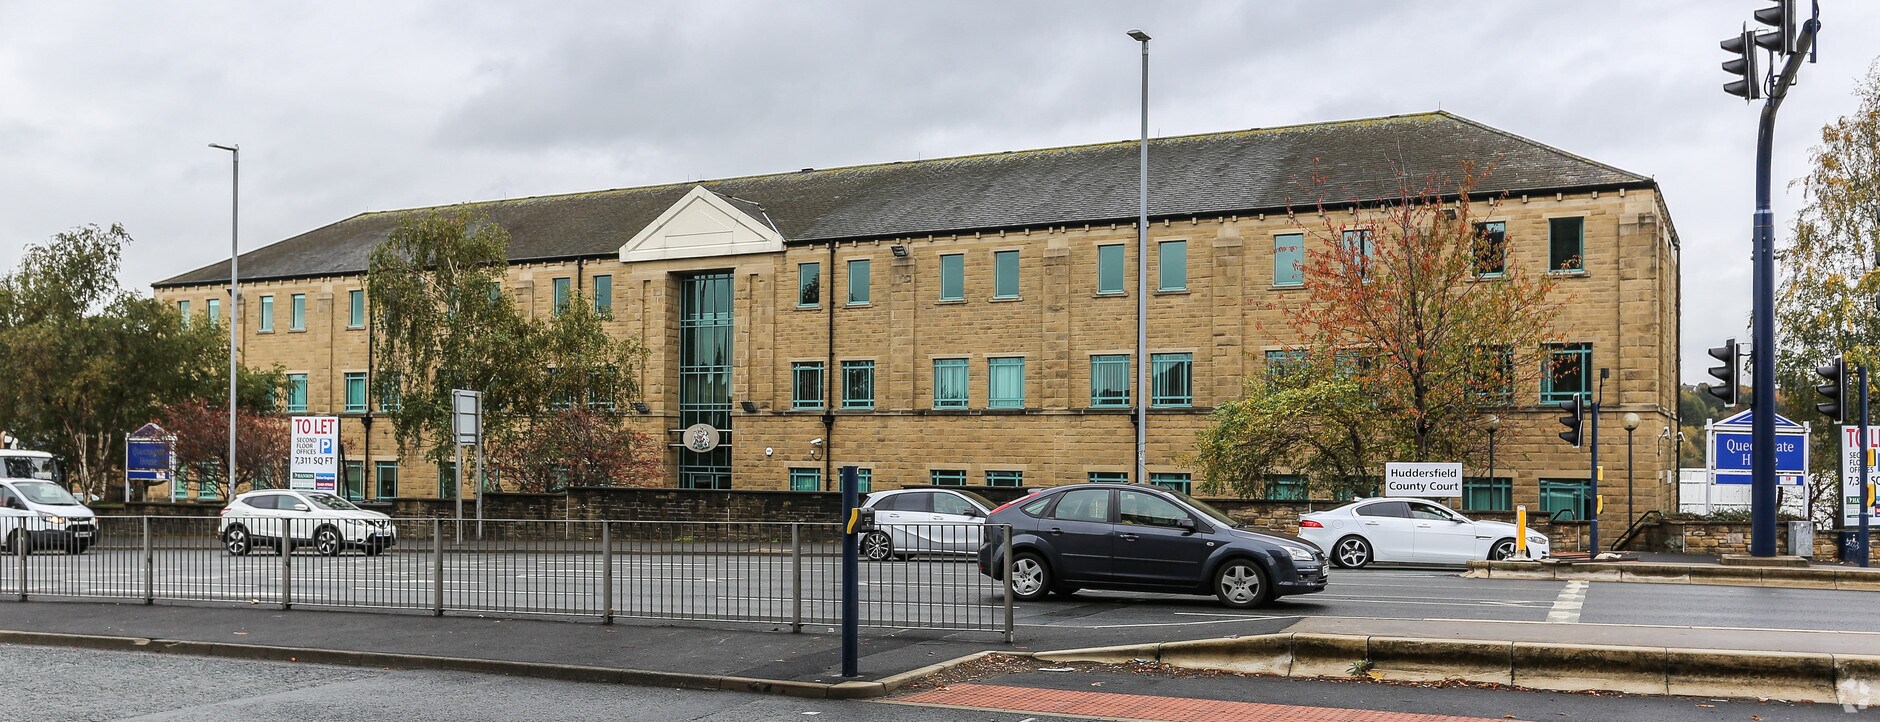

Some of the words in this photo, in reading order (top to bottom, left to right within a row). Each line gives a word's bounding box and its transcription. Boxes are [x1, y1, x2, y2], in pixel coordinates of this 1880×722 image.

[295, 418, 311, 434] TO
[315, 418, 335, 434] LET
[321, 439, 331, 453] P
[1726, 439, 1794, 454] Queate
[295, 456, 311, 466] 7,311
[313, 456, 324, 466] SQ
[325, 457, 334, 465] FT
[1390, 468, 1457, 478] Huddersfield
[1389, 481, 1427, 493] County
[1429, 481, 1459, 491] Court
